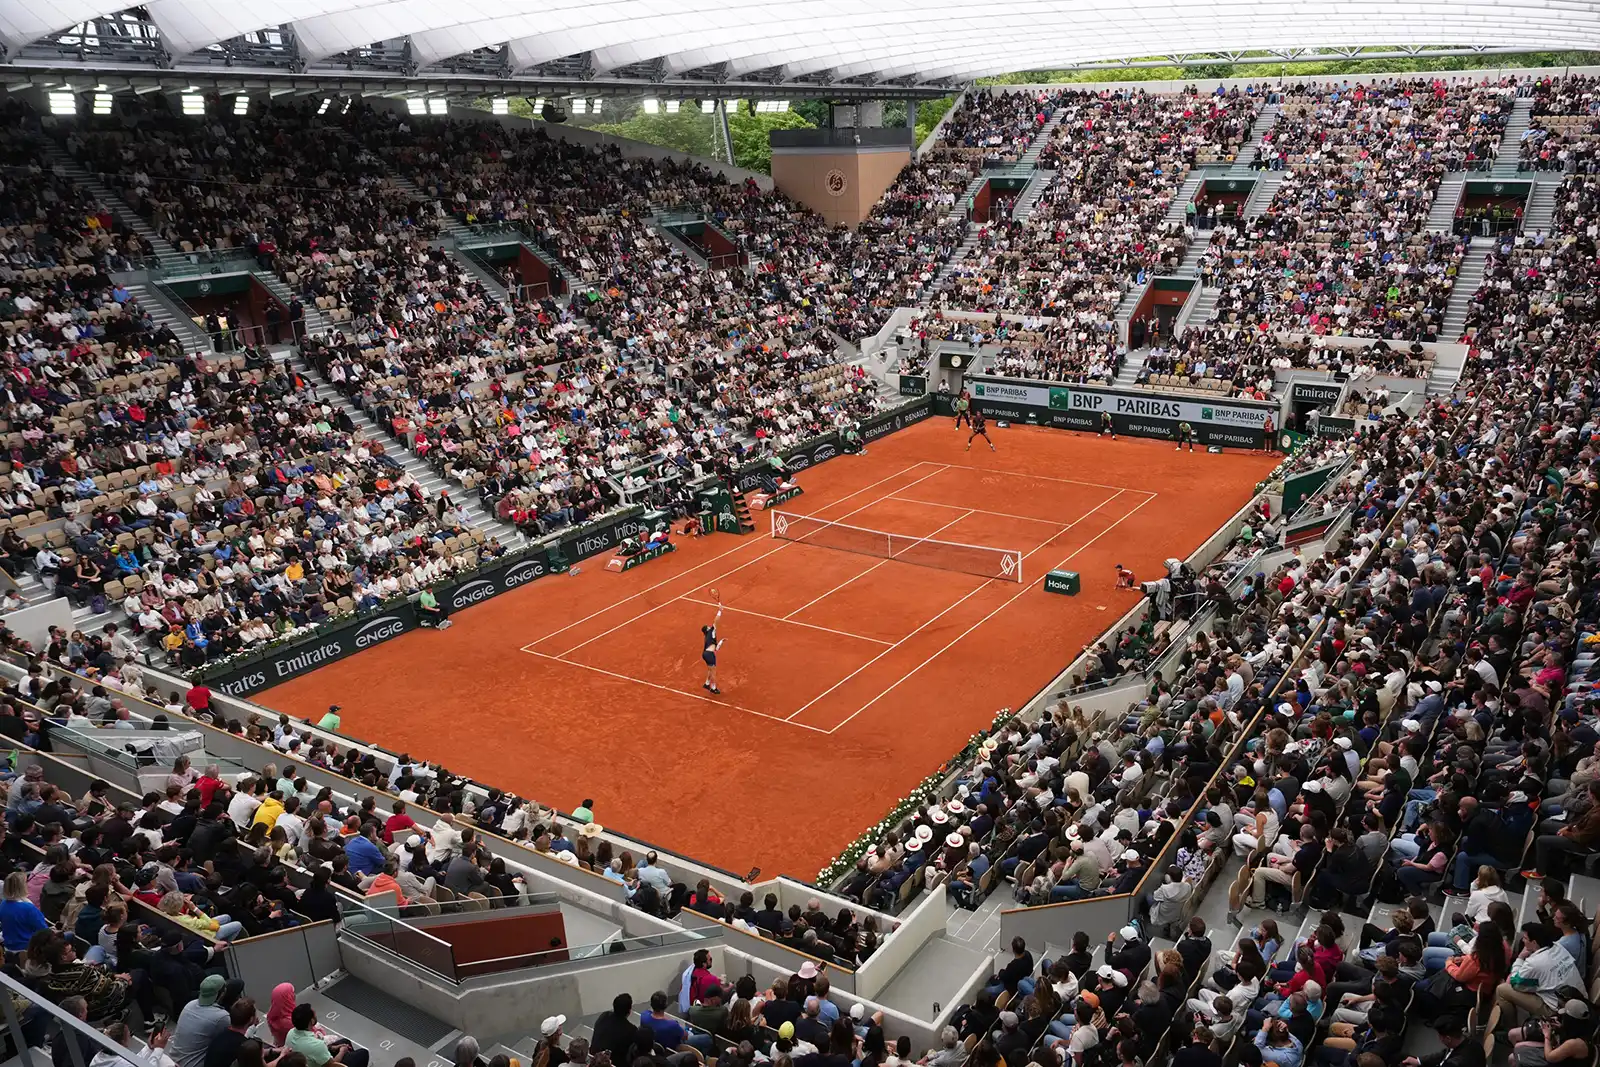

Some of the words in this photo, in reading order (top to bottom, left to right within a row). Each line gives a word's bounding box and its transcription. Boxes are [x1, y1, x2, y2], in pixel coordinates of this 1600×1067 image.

[1001, 387, 1027, 396] PARIBAS
[1295, 387, 1338, 399] Emirates
[1073, 394, 1103, 409] BNP
[1117, 398, 1180, 418] PARIBAS
[905, 407, 929, 423] RENAULT
[995, 409, 1019, 417] PARIBAS
[1215, 409, 1231, 417] BNP
[1232, 411, 1265, 421] PARIBAS
[1067, 417, 1092, 426] PARIBAS
[865, 422, 891, 438] RENAULT
[1143, 425, 1170, 435] PARIBAS
[1224, 434, 1253, 444] PARIBAS
[614, 521, 638, 540] Infos
[576, 533, 609, 555] Infosys
[1048, 579, 1070, 590] Haier
[275, 641, 341, 677] Emirates
[220, 671, 266, 696] irates
